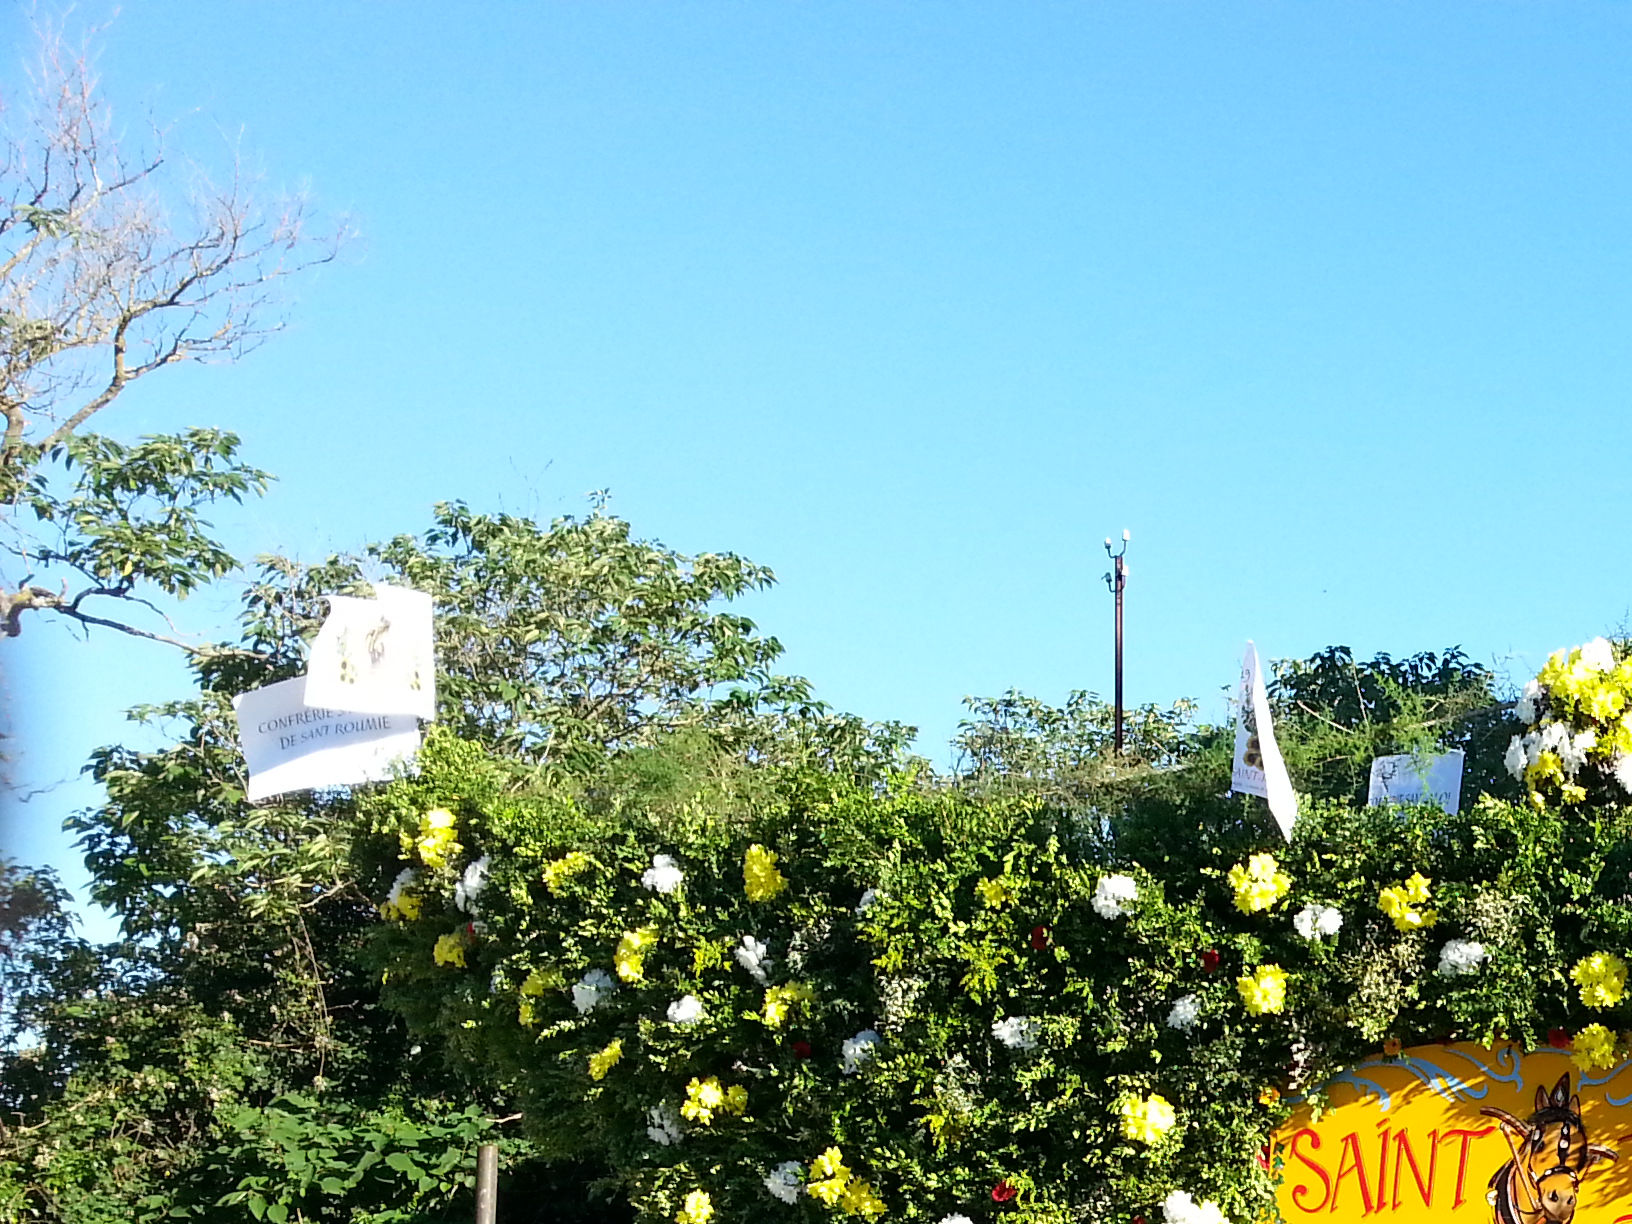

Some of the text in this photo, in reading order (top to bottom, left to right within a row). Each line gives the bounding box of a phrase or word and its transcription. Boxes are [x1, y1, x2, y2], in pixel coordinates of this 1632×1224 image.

[279, 716, 391, 750] DE SANT ROUMIE
[1289, 1118, 1496, 1218] SAINT
